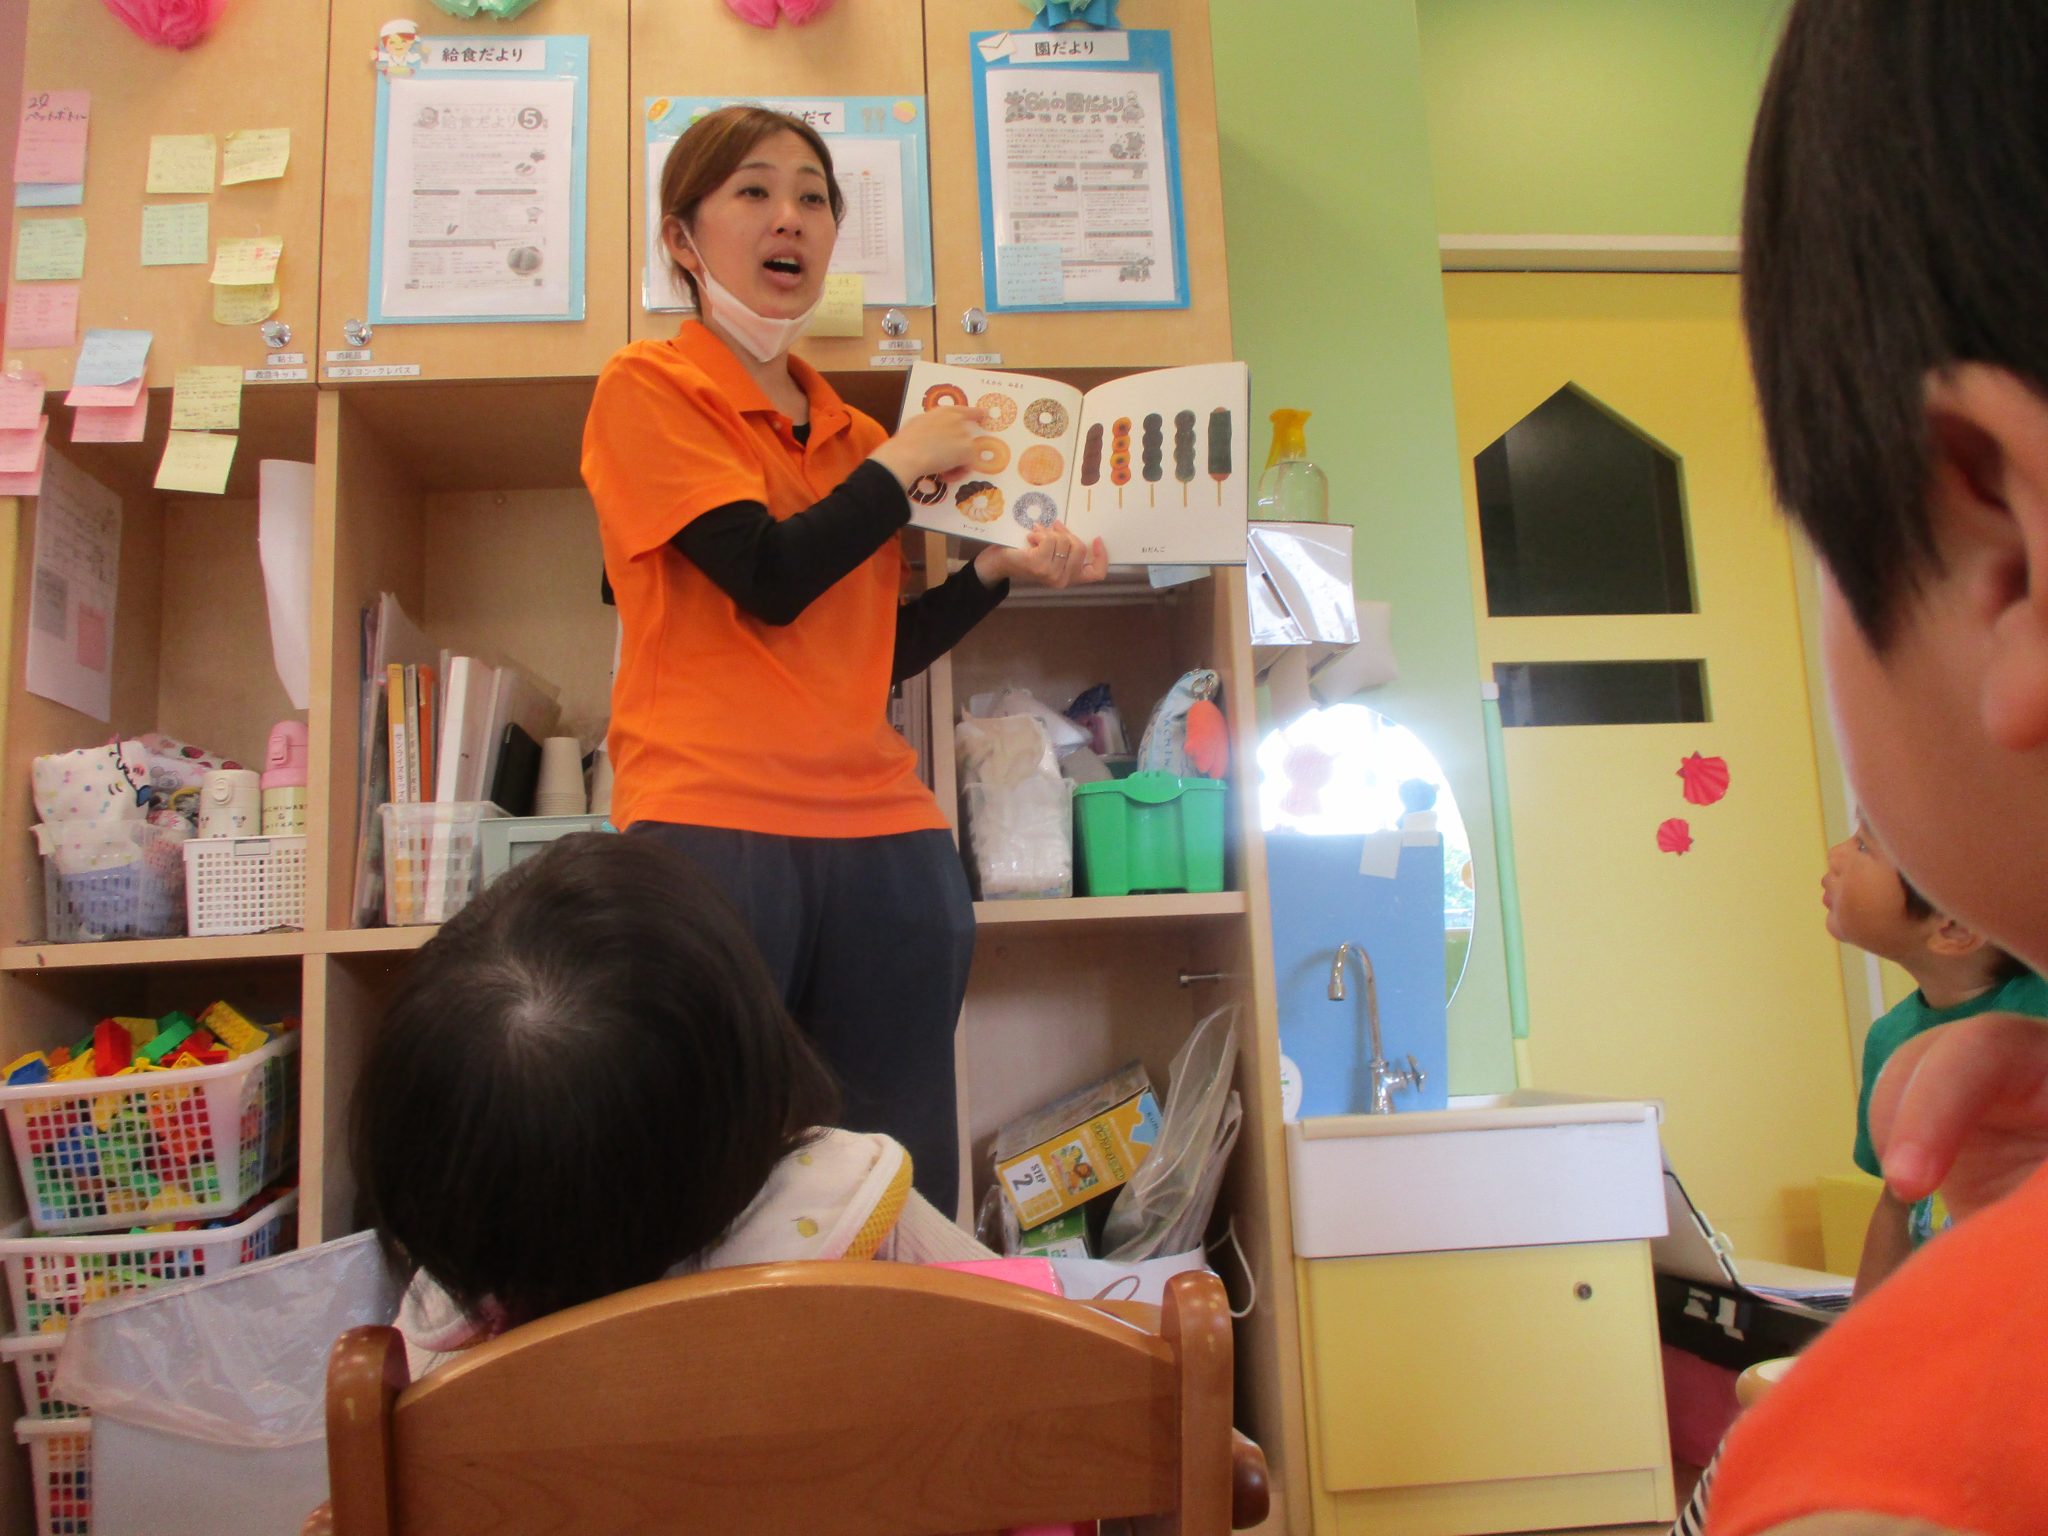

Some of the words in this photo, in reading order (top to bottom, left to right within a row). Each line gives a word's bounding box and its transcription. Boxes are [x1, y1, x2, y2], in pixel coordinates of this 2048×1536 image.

[441, 47, 524, 62] 給食だより
[1035, 41, 1094, 56] 園だより
[1030, 1163, 1047, 1184] STEP
[1012, 1174, 1033, 1191] 2
